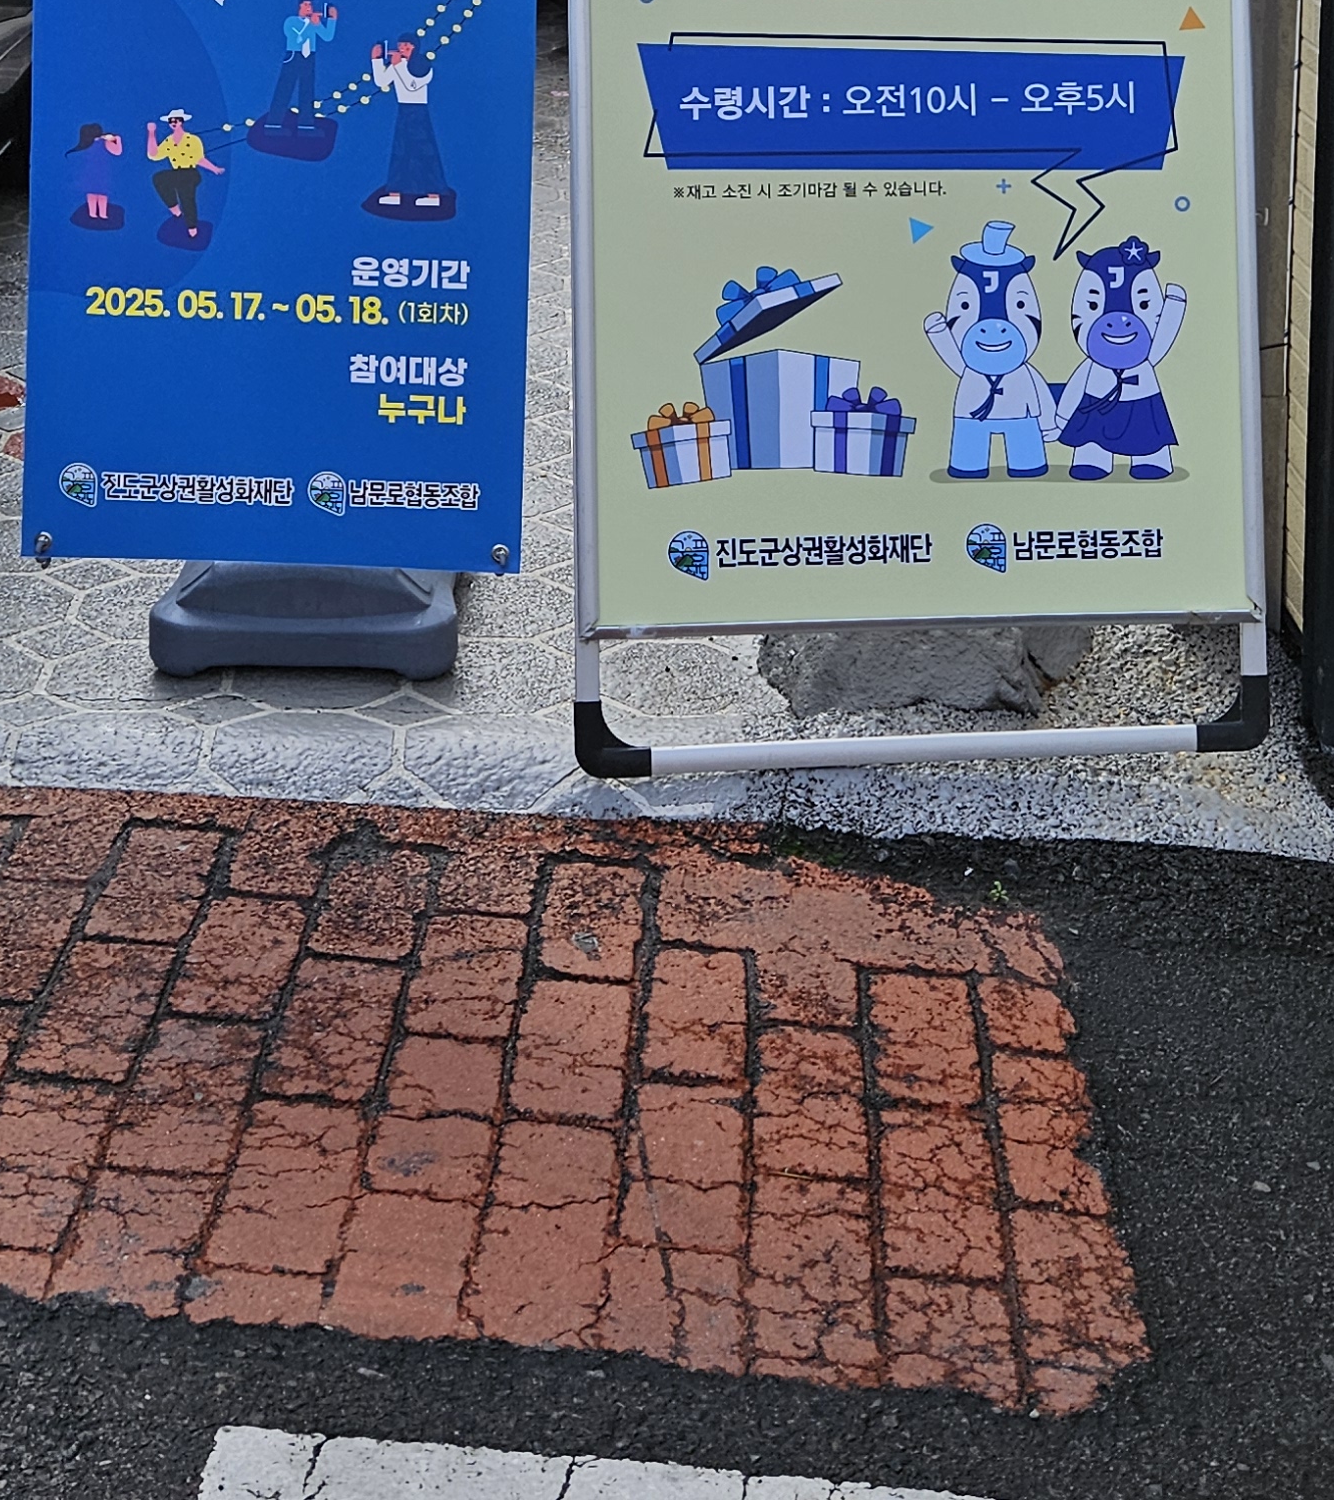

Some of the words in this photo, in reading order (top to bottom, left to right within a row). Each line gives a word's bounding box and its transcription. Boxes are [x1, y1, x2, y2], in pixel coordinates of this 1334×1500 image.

[679, 85, 810, 121] 수령시간
[842, 83, 977, 118] 오전10시
[1021, 80, 1136, 115] 오후5시
[722, 183, 752, 199] 소진
[757, 183, 771, 198] 시
[778, 182, 837, 198] 조기마감
[863, 182, 878, 197] 수
[884, 180, 947, 197] 있습니다.
[351, 256, 470, 289] 운영기간
[85, 286, 171, 318] 2025.
[177, 289, 224, 320] 05.
[230, 292, 266, 321] 17.
[295, 293, 342, 324] 05.
[348, 296, 389, 326] 18.
[397, 300, 469, 326] (1회차)
[349, 354, 468, 387] 참여대상
[377, 393, 467, 425] 누구나
[101, 472, 294, 506] 진도군상권활성화재단
[350, 480, 479, 510] 남문로협동조합
[716, 533, 933, 567] 진도군상권활성화재단
[1014, 529, 1164, 560] 남문로협동조합
